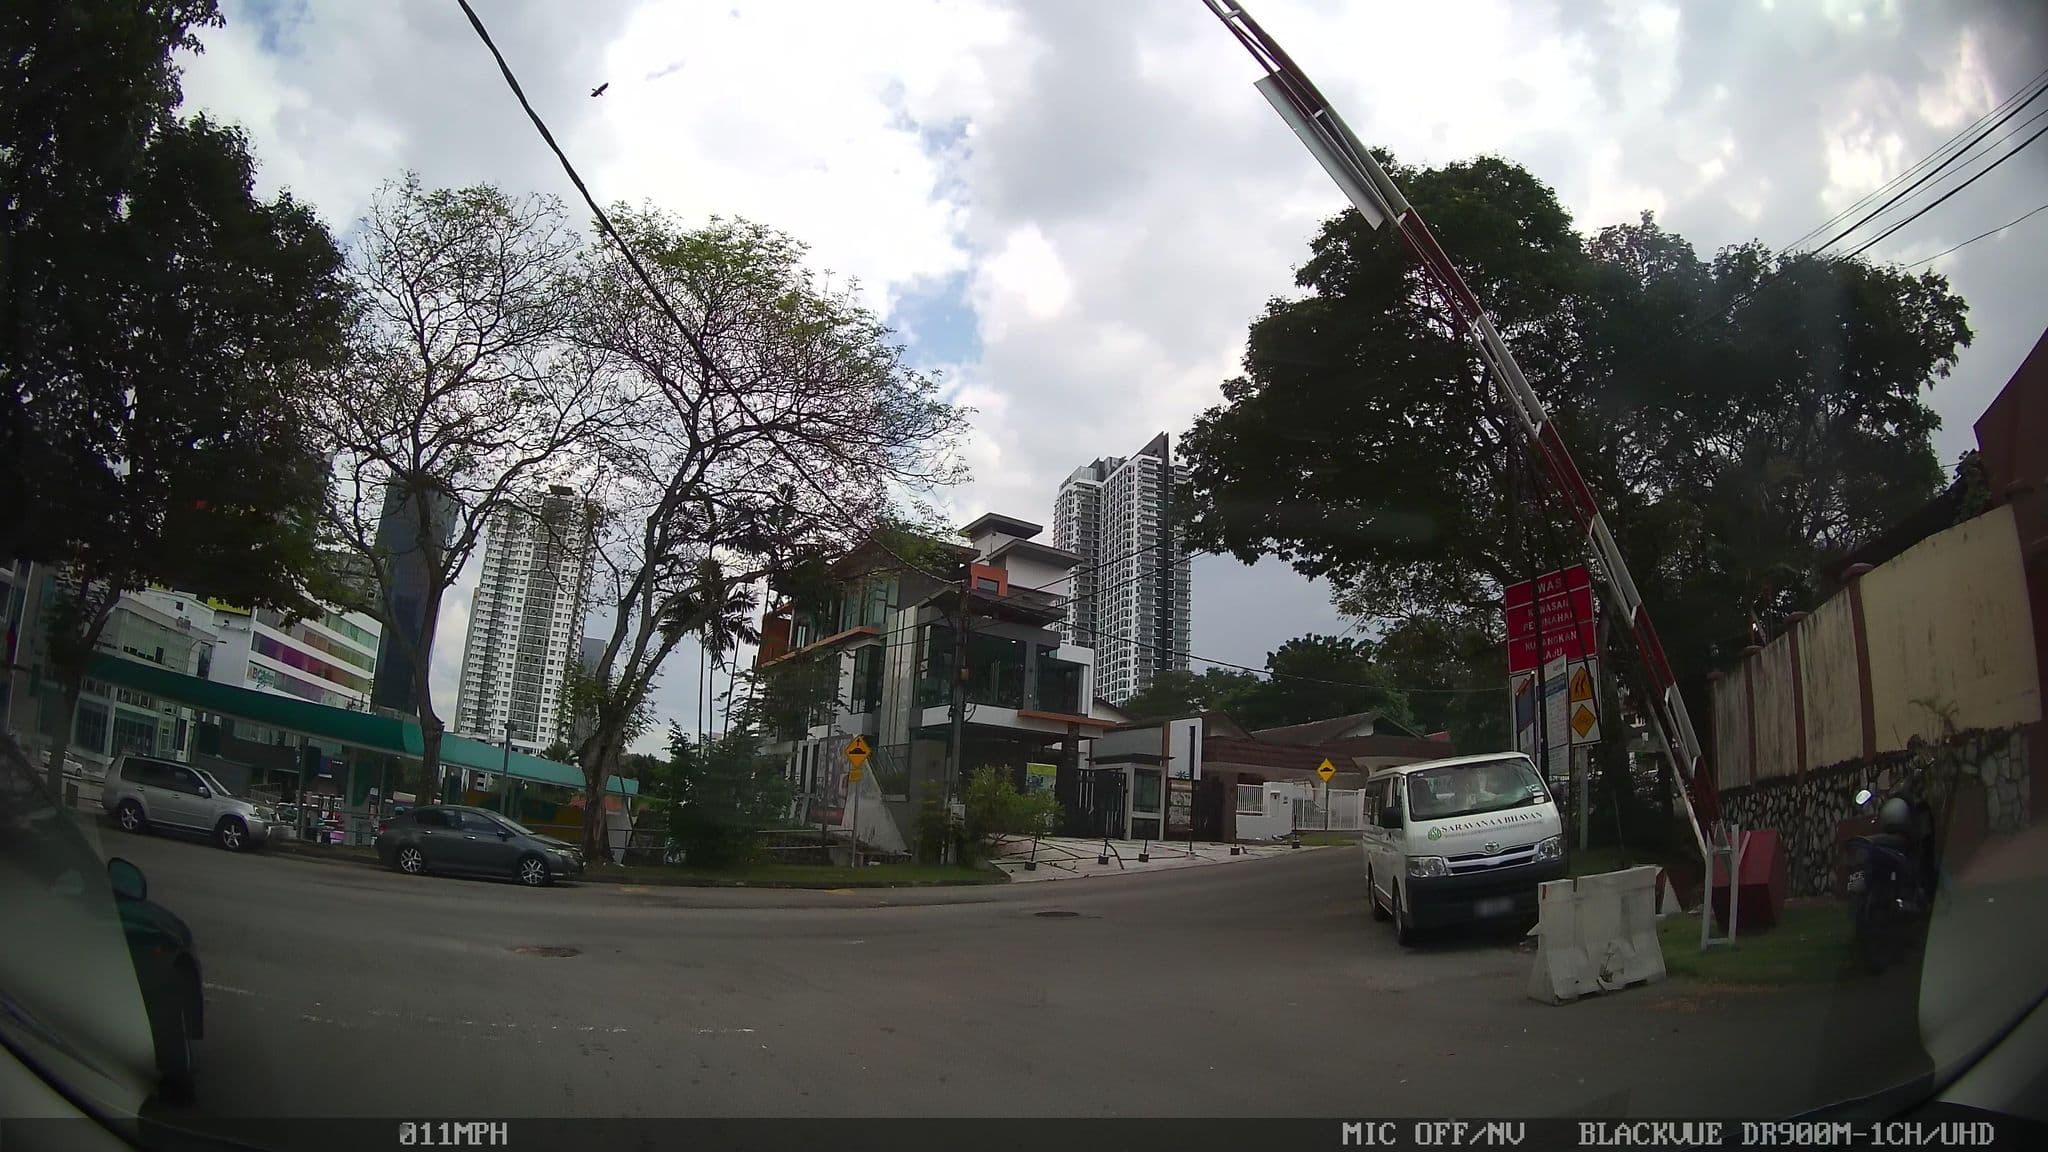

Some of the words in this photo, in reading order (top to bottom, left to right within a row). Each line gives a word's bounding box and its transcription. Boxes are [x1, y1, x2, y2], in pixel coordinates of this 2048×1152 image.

[1534, 577, 1562, 594] WAS
[1541, 647, 1563, 661] AJU
[1504, 811, 1543, 824] BHAVAN
